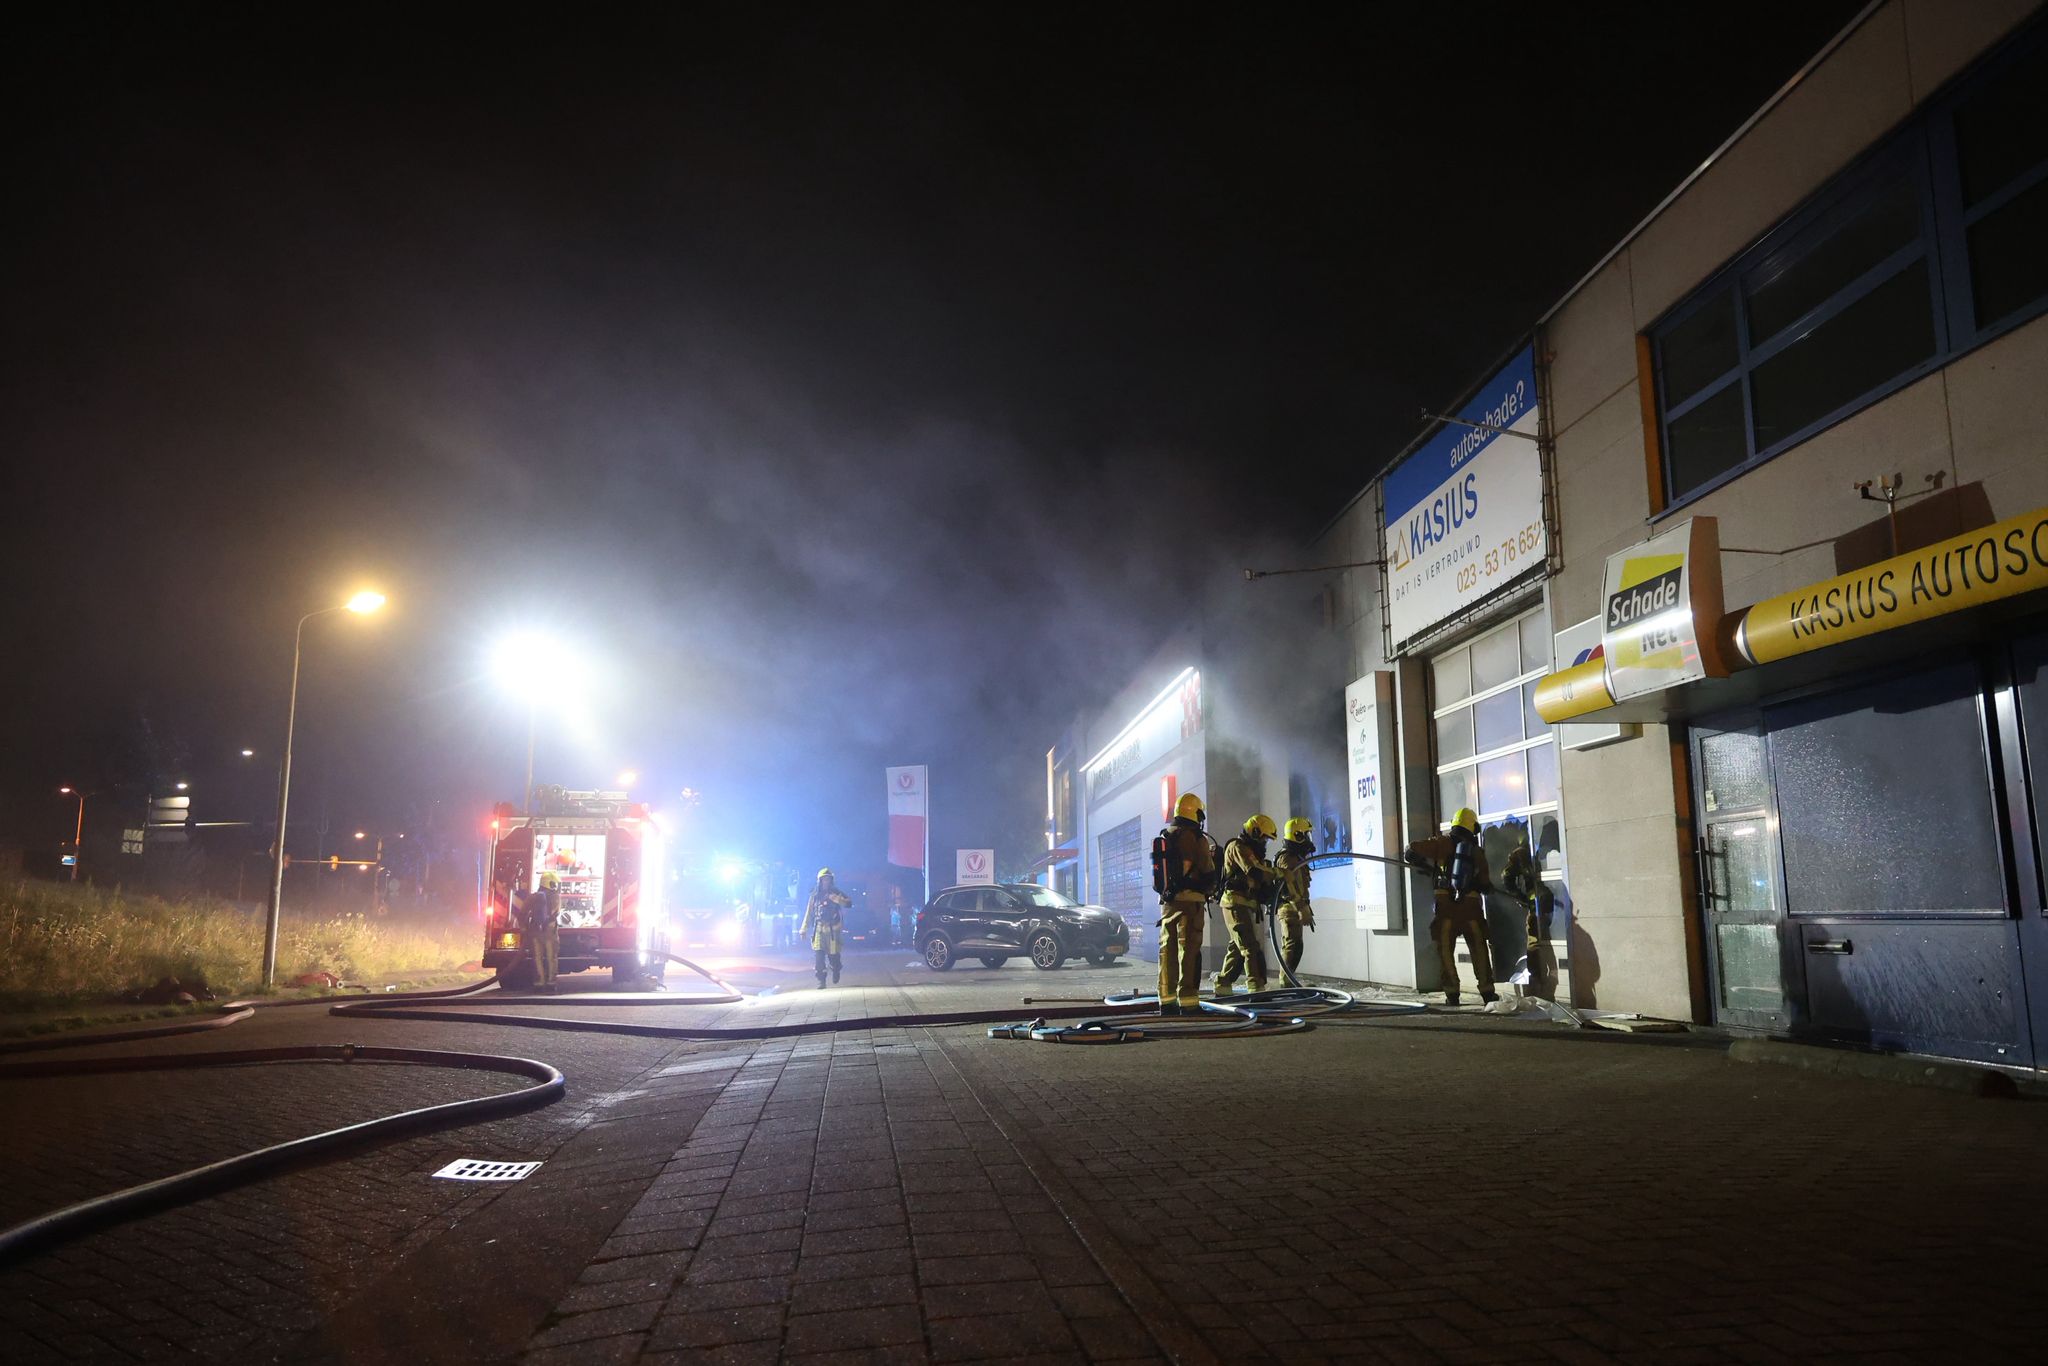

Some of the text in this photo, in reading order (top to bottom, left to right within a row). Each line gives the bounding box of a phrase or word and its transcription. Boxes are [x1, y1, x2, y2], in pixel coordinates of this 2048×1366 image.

[1450, 380, 1524, 468] autoschade?
[1410, 473, 1478, 560] KASIUS
[1395, 534, 1480, 600] DAT IS VERTROUWD
[1456, 563, 1477, 593] 023
[1485, 549, 1499, 576] 53
[1501, 537, 1516, 566] 76
[1610, 577, 1676, 627] Schade
[1790, 570, 1898, 639] KASIUS
[1357, 774, 1377, 799] FBTO
